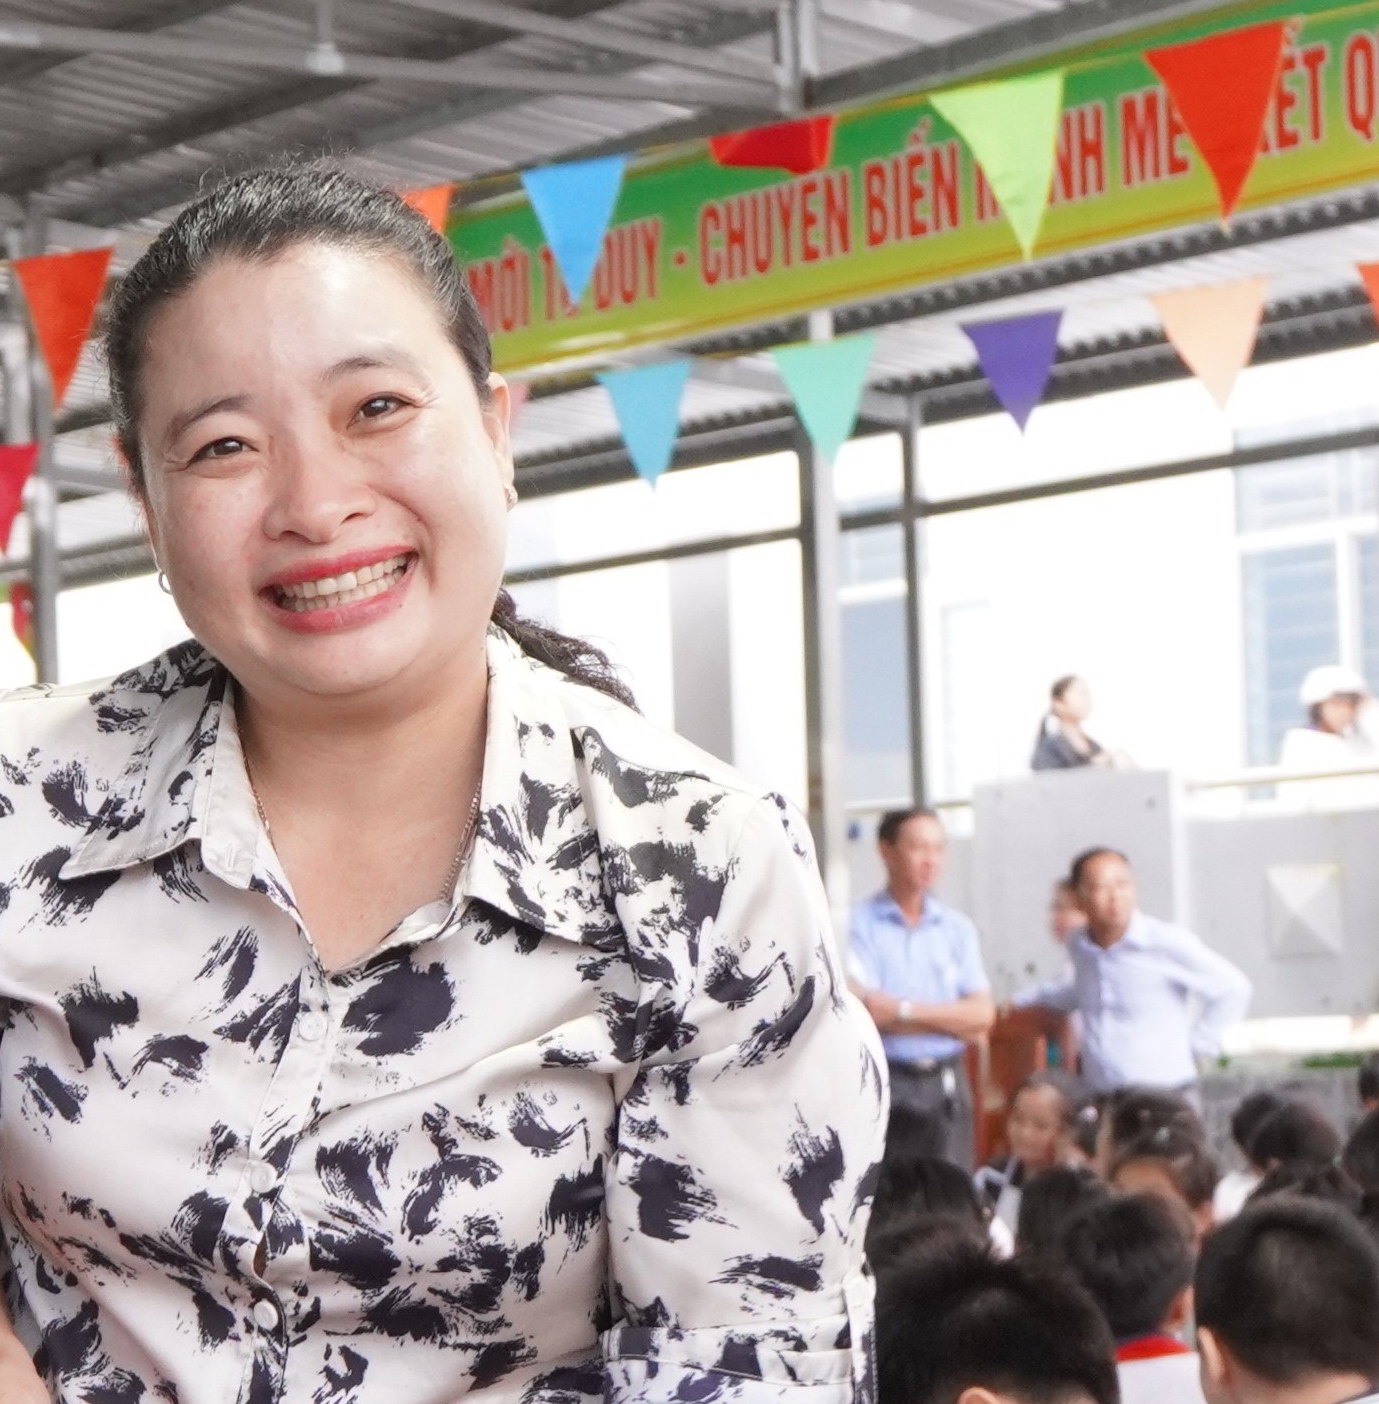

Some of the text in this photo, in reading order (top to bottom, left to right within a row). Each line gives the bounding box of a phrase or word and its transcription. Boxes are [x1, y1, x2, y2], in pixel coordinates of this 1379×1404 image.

[593, 217, 662, 311] DUY
[864, 114, 961, 248] BIẾN
[1259, 15, 1328, 155] ẾT
